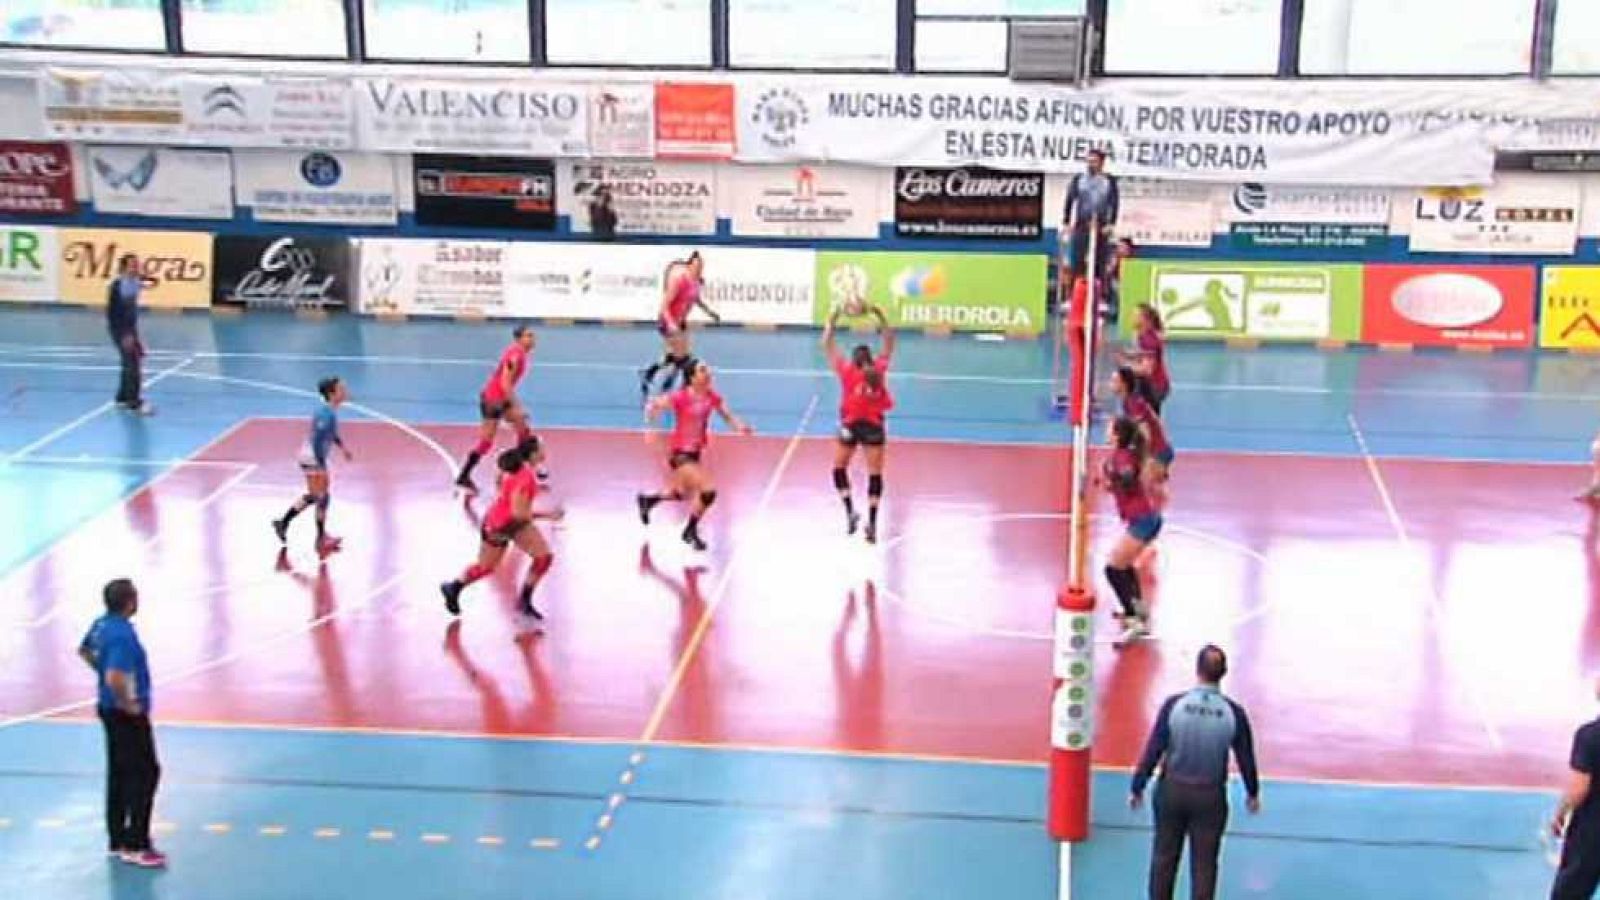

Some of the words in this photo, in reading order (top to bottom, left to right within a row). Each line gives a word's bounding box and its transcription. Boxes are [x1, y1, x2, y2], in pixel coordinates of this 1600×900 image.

[368, 81, 578, 120] VALENCISO
[828, 93, 923, 119] MUCHAS
[928, 95, 1028, 123] GRACIAS
[1136, 106, 1184, 132] POR
[1191, 107, 1301, 135] VUESTRO
[1305, 111, 1391, 136] APOYO
[945, 130, 974, 155] EN
[981, 132, 1035, 158] ESTA
[1043, 137, 1116, 162] NUEVA
[1125, 141, 1268, 170] TEMPORADA
[610, 182, 711, 197] MENDOZA
[1416, 197, 1484, 222] LUZ
[64, 240, 205, 287] Mga
[902, 302, 1031, 327] IBERDROLA
